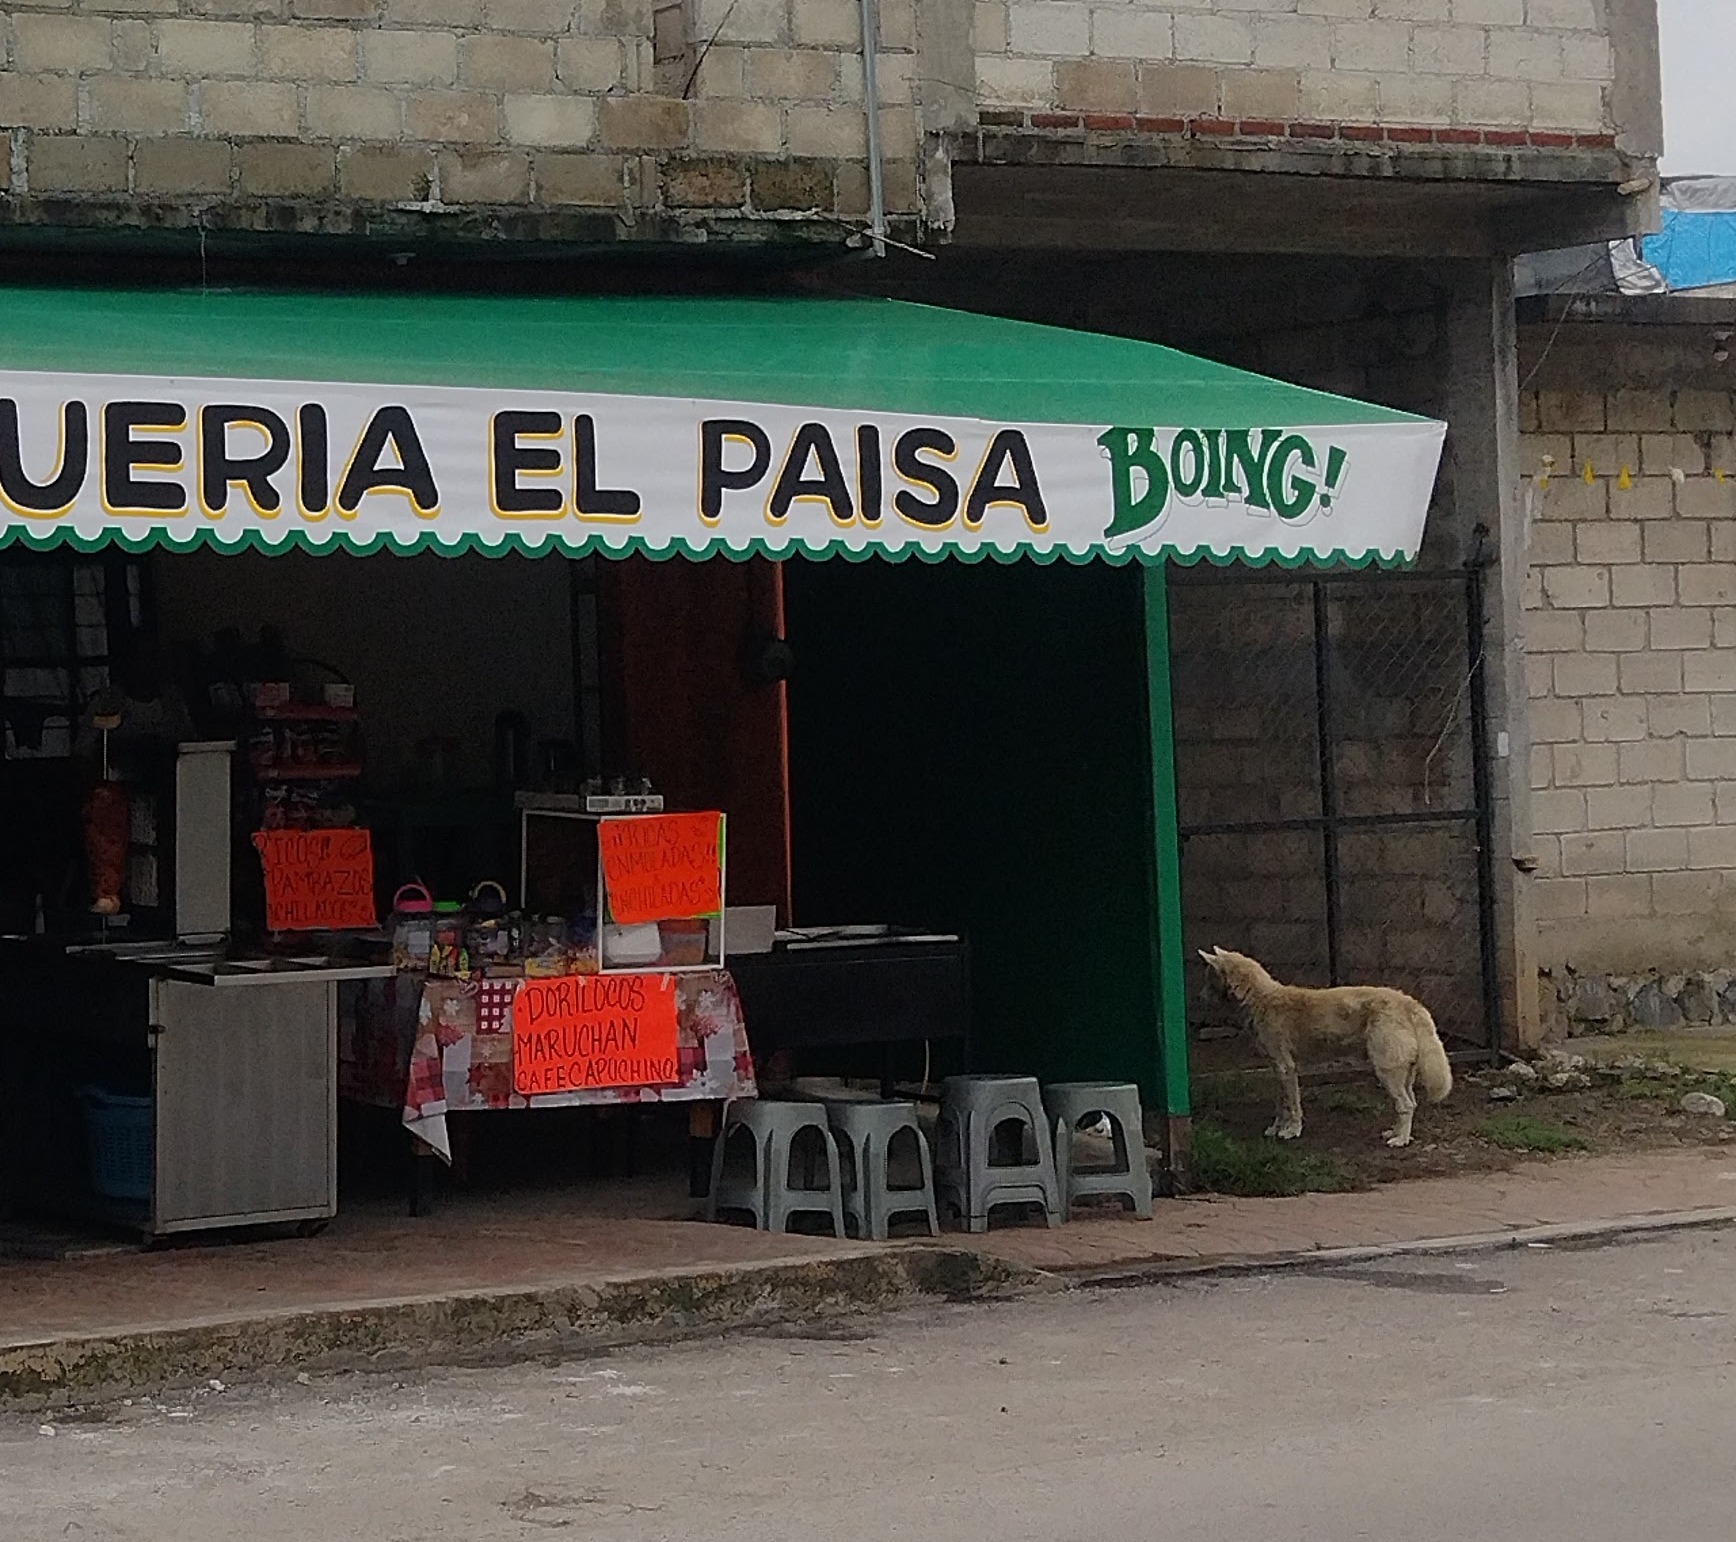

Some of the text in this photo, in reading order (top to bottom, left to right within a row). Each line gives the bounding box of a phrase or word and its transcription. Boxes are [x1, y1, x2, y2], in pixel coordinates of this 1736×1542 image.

[488, 408, 643, 523] EL
[696, 417, 1050, 534] PAISA
[1097, 425, 1349, 541] BOING!
[524, 976, 646, 1025] DORILOCOS
[515, 1016, 640, 1067] MARUCHAN
